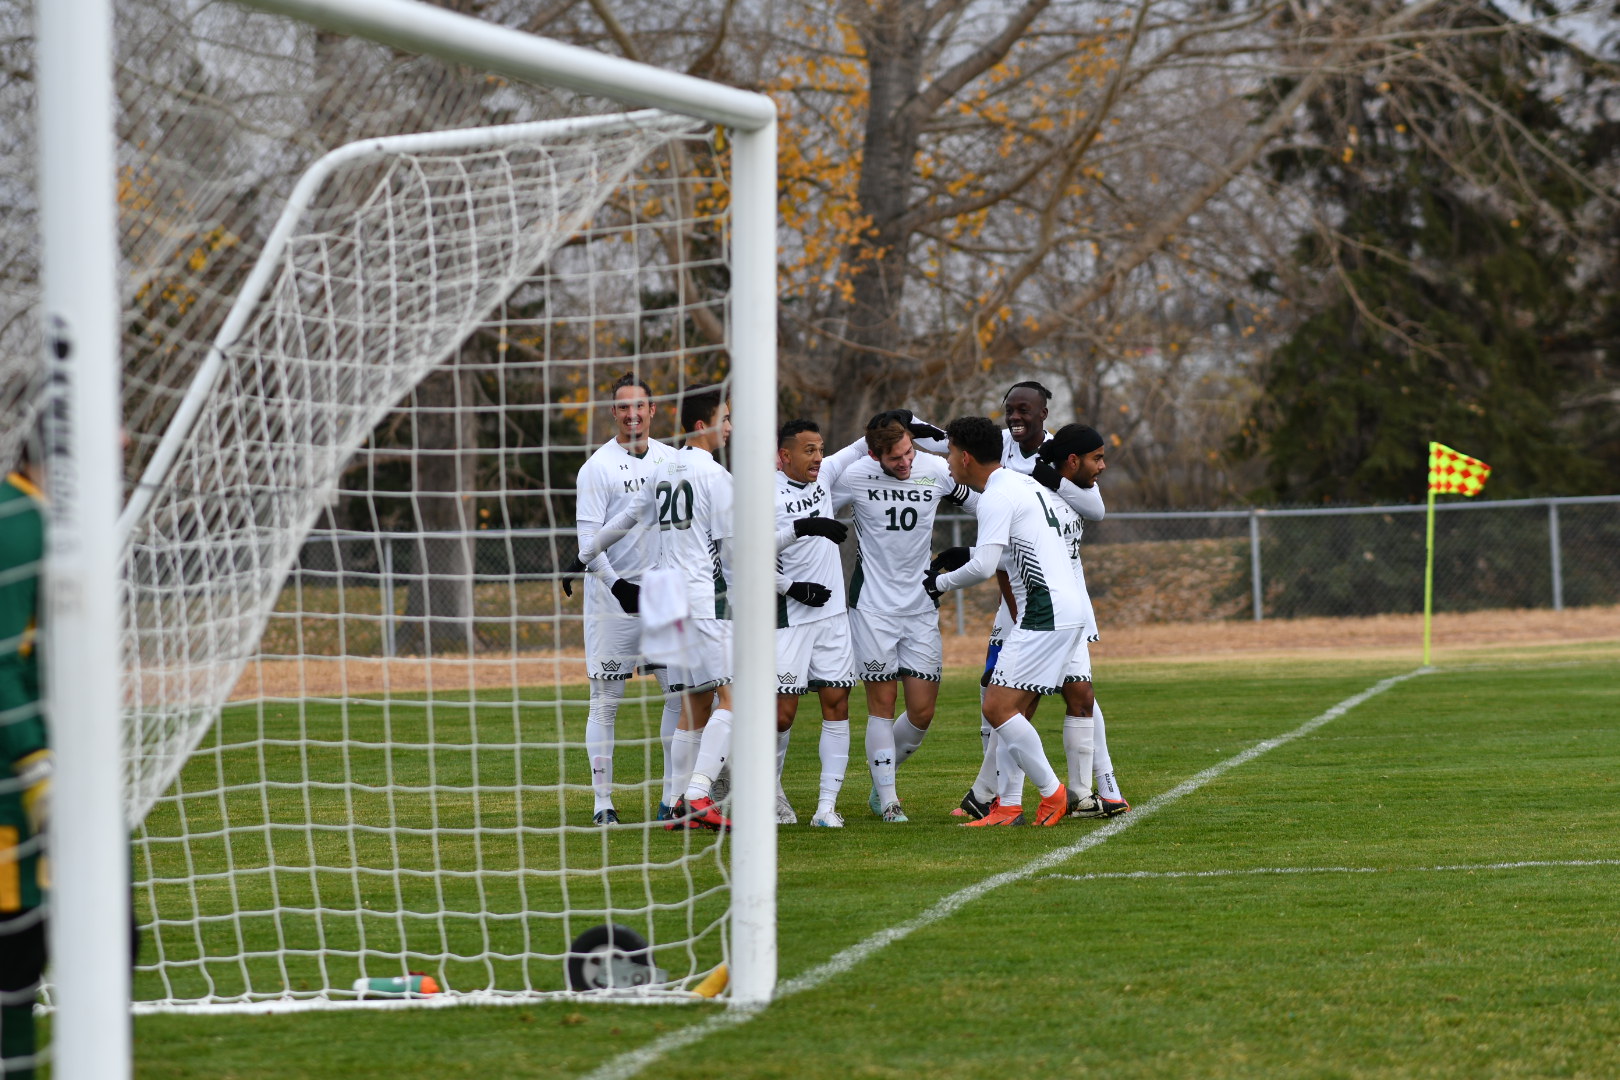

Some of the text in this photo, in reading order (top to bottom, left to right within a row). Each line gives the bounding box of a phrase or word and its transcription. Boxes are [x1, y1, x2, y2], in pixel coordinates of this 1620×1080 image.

[656, 479, 694, 531] 20
[785, 485, 825, 513] KINGS
[868, 489, 932, 502] KINGS
[886, 507, 918, 531] 10
[1036, 492, 1062, 537] 4
